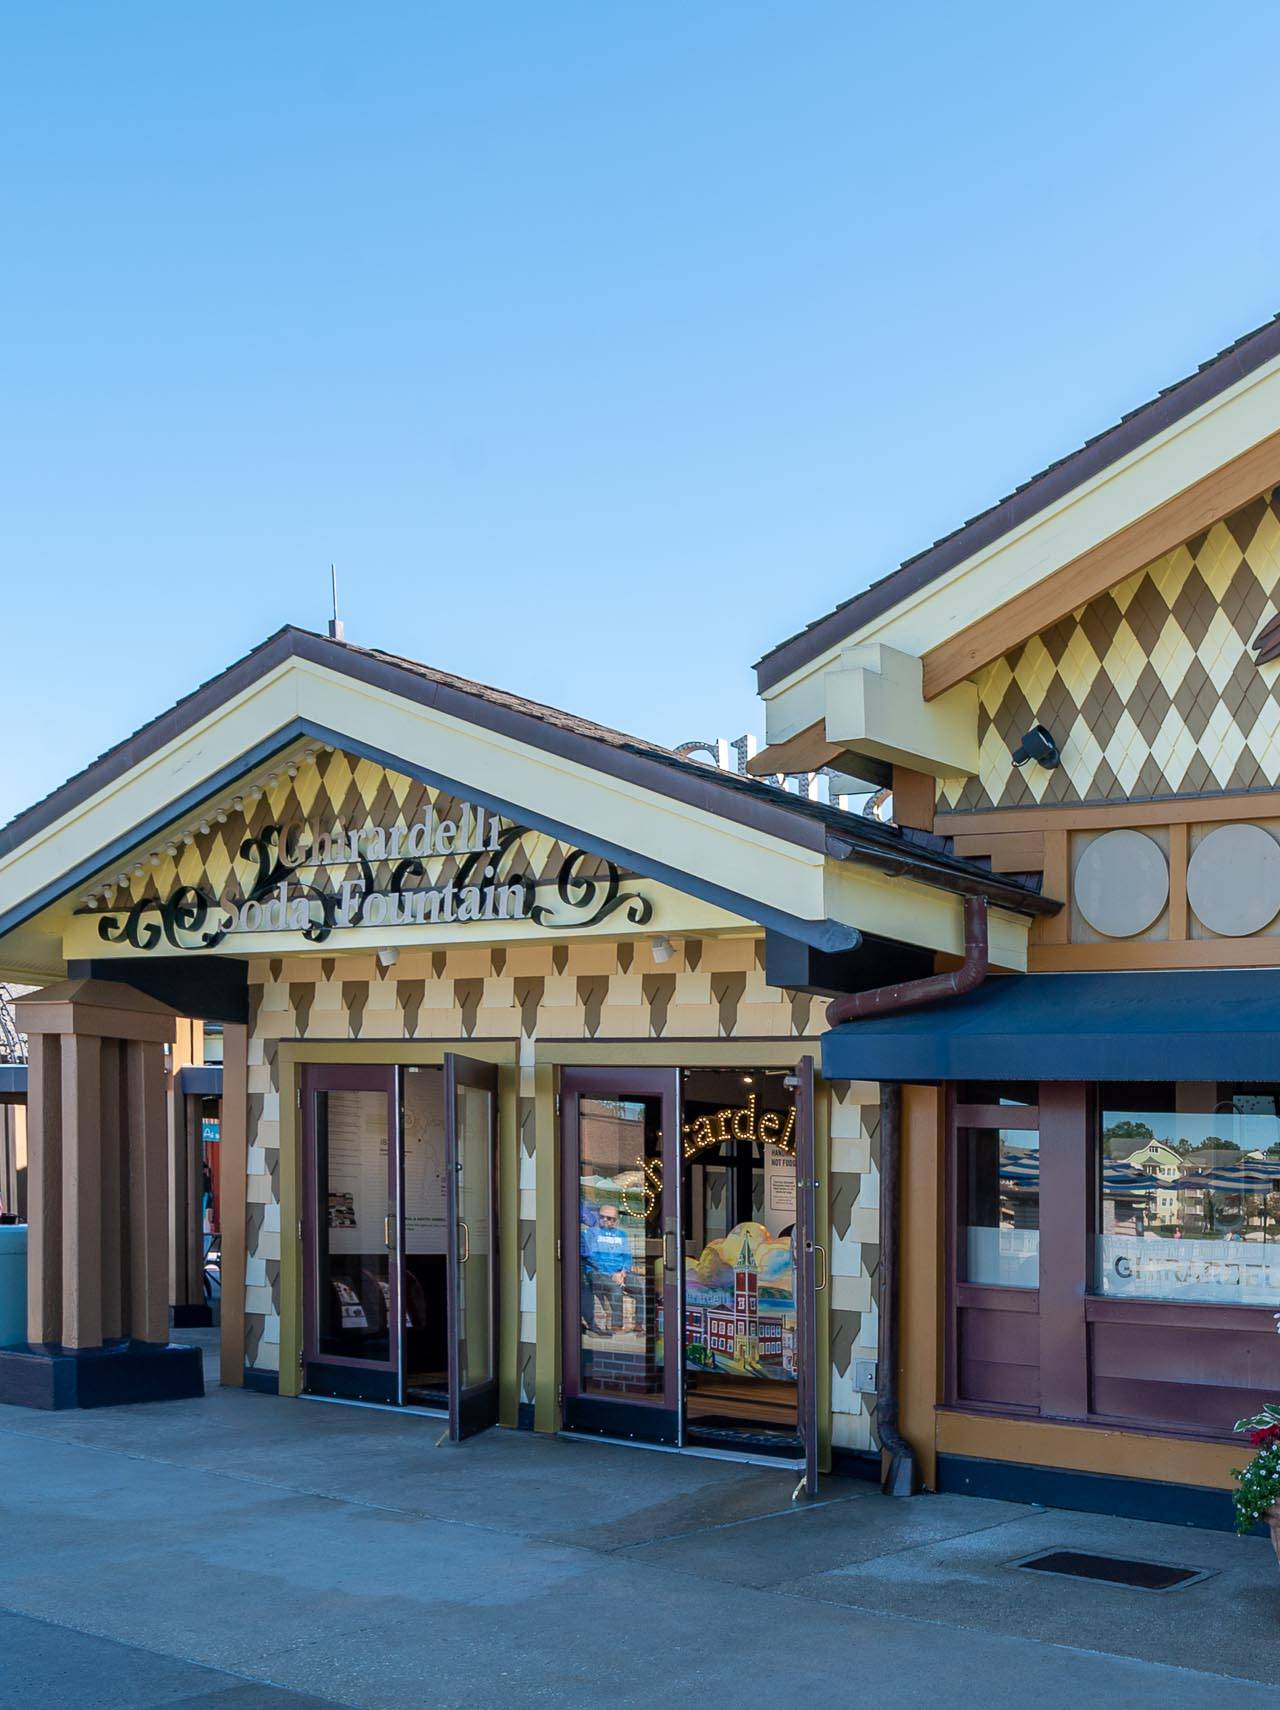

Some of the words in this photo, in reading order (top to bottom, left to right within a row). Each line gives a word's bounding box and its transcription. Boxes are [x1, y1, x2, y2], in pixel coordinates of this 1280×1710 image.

[278, 802, 501, 867] Ghirardelli
[219, 881, 312, 932] Soda
[335, 866, 531, 928] Fountain
